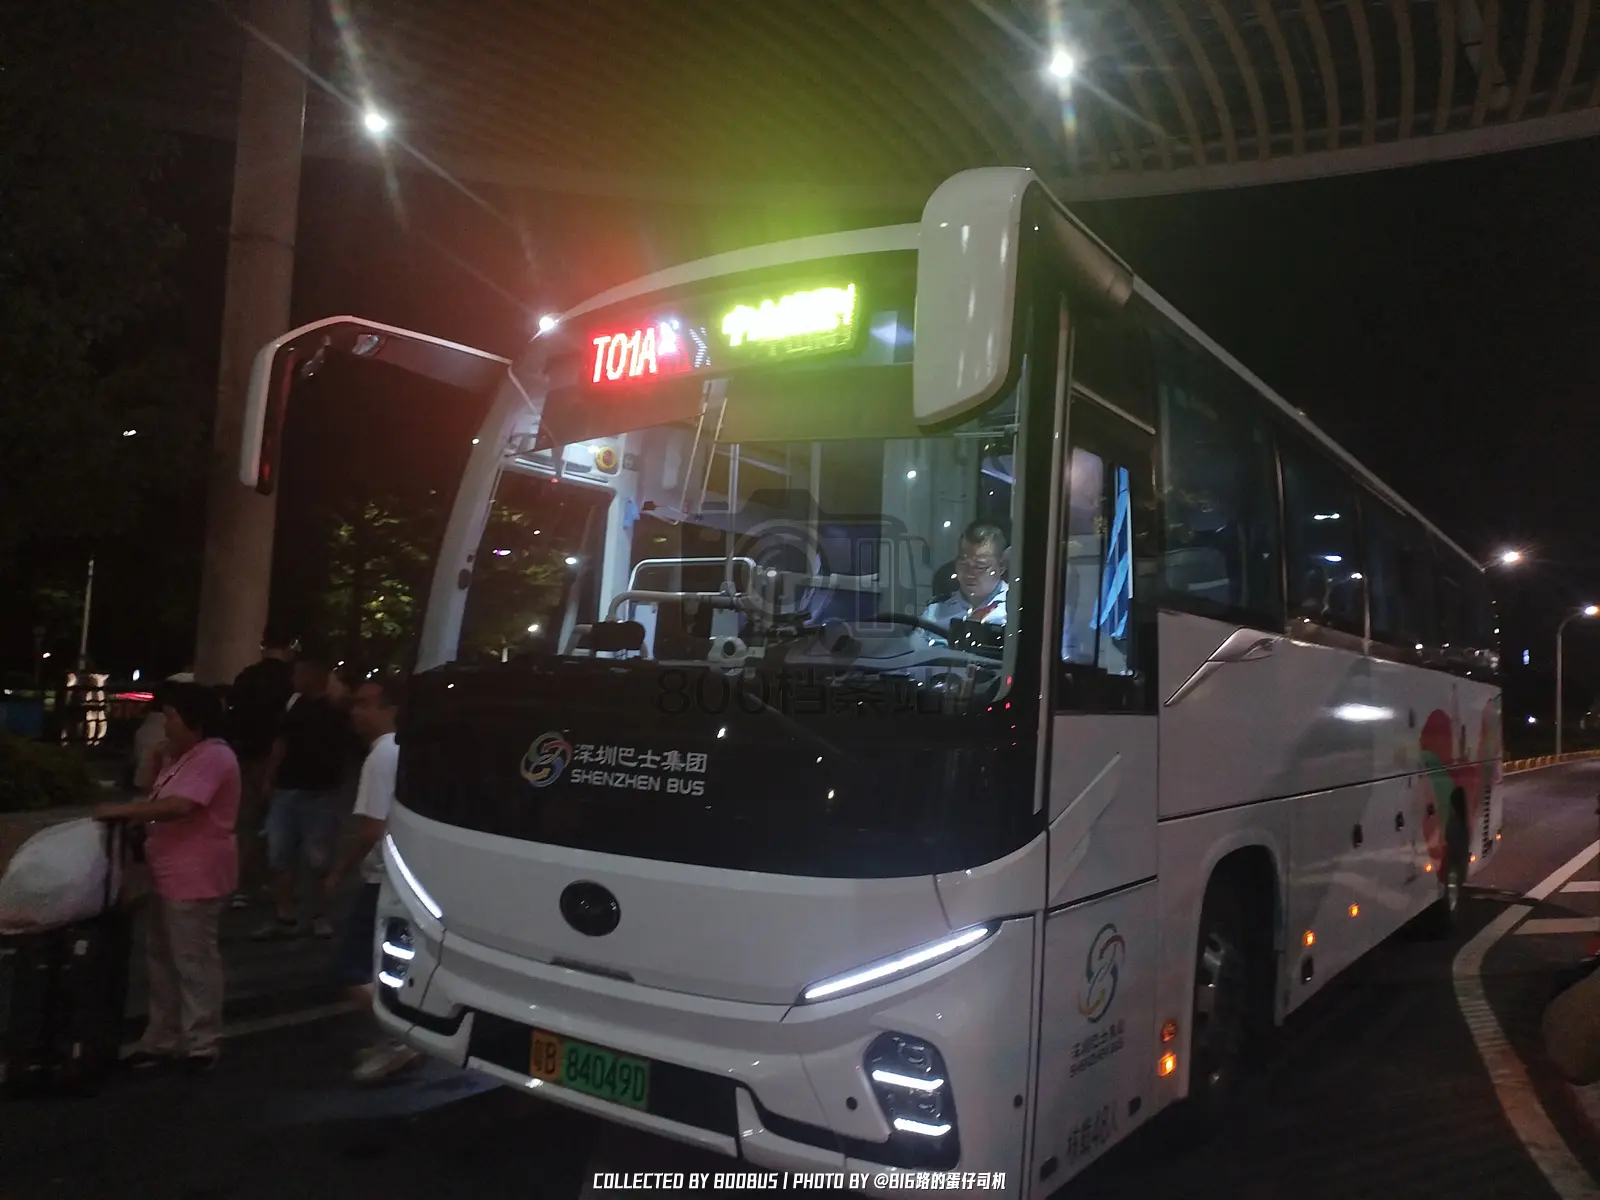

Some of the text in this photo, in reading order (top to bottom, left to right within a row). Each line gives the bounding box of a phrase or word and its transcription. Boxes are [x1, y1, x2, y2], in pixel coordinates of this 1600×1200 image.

[573, 743, 708, 773] 深圳巴士集团
[570, 768, 706, 796] SHENZHEN BUS
[566, 1047, 646, 1102] 84049D
